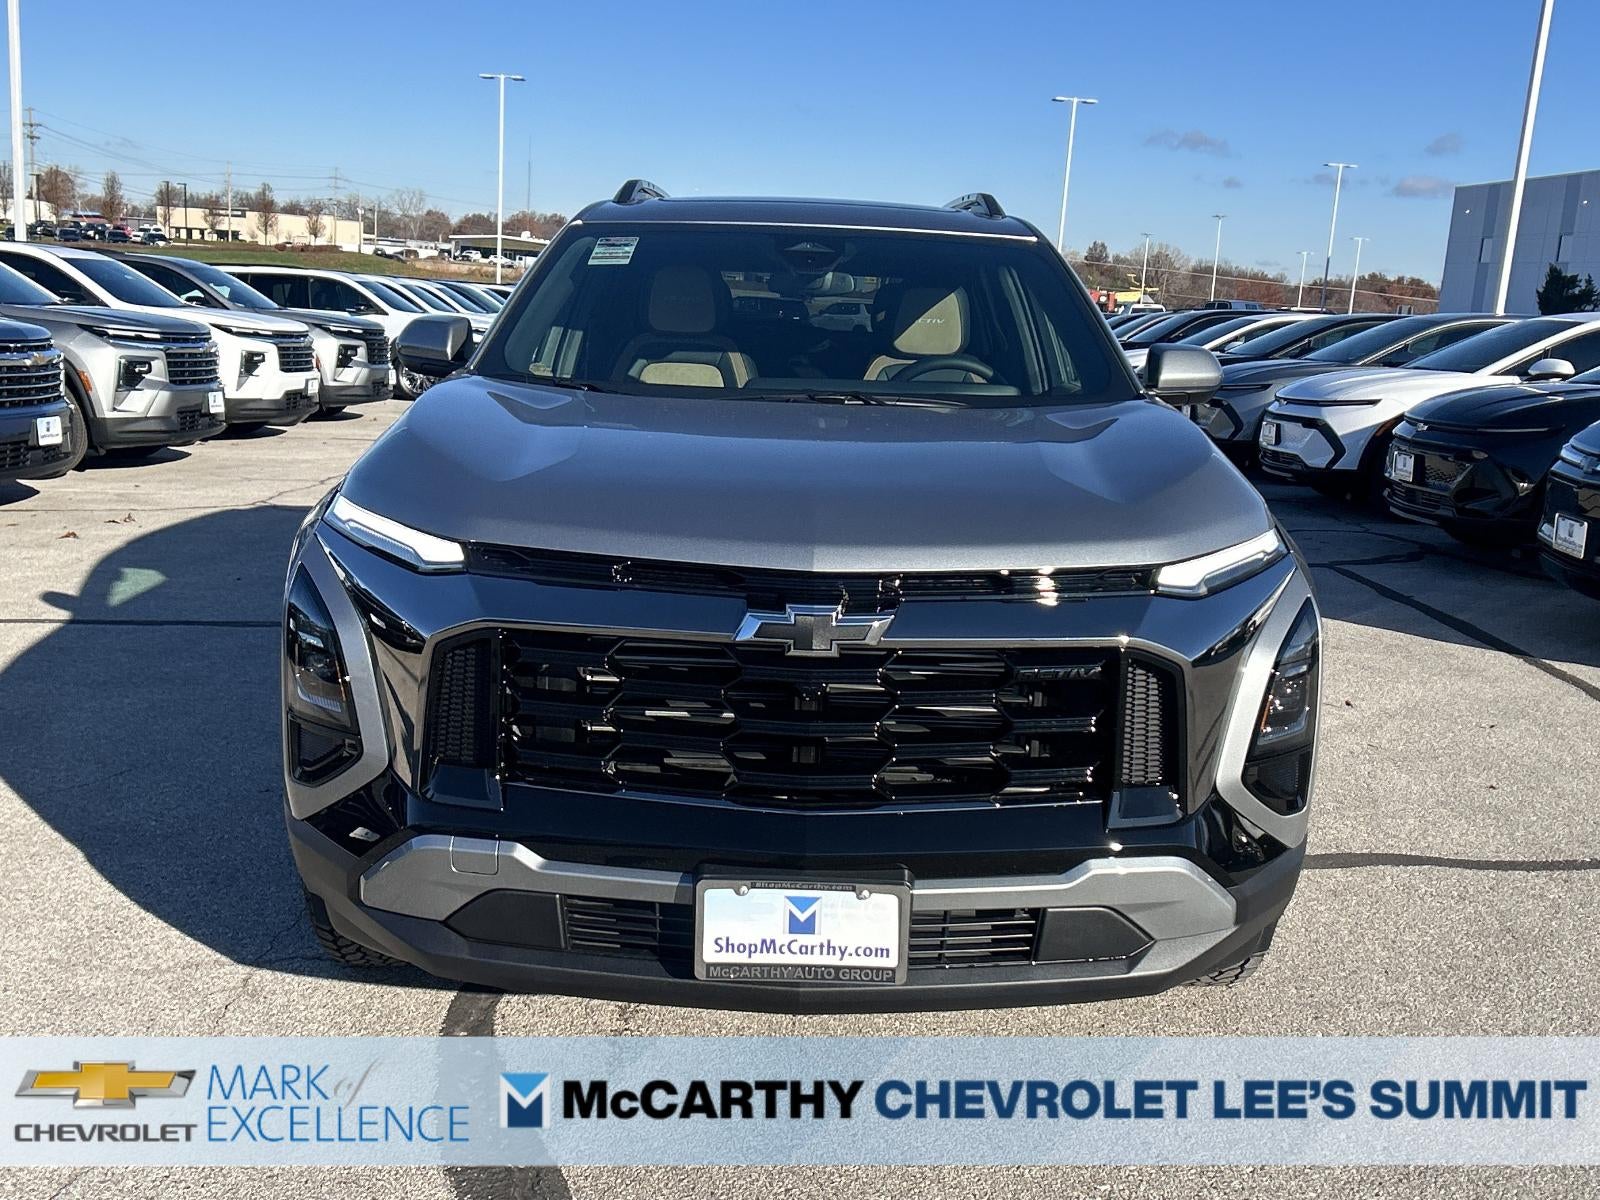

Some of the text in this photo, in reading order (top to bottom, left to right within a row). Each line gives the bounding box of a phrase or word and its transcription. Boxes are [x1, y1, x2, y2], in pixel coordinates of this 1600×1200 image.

[713, 936, 890, 961] ShopMcCarthy.com
[708, 965, 893, 981] McCARTHY AUTO GROUP
